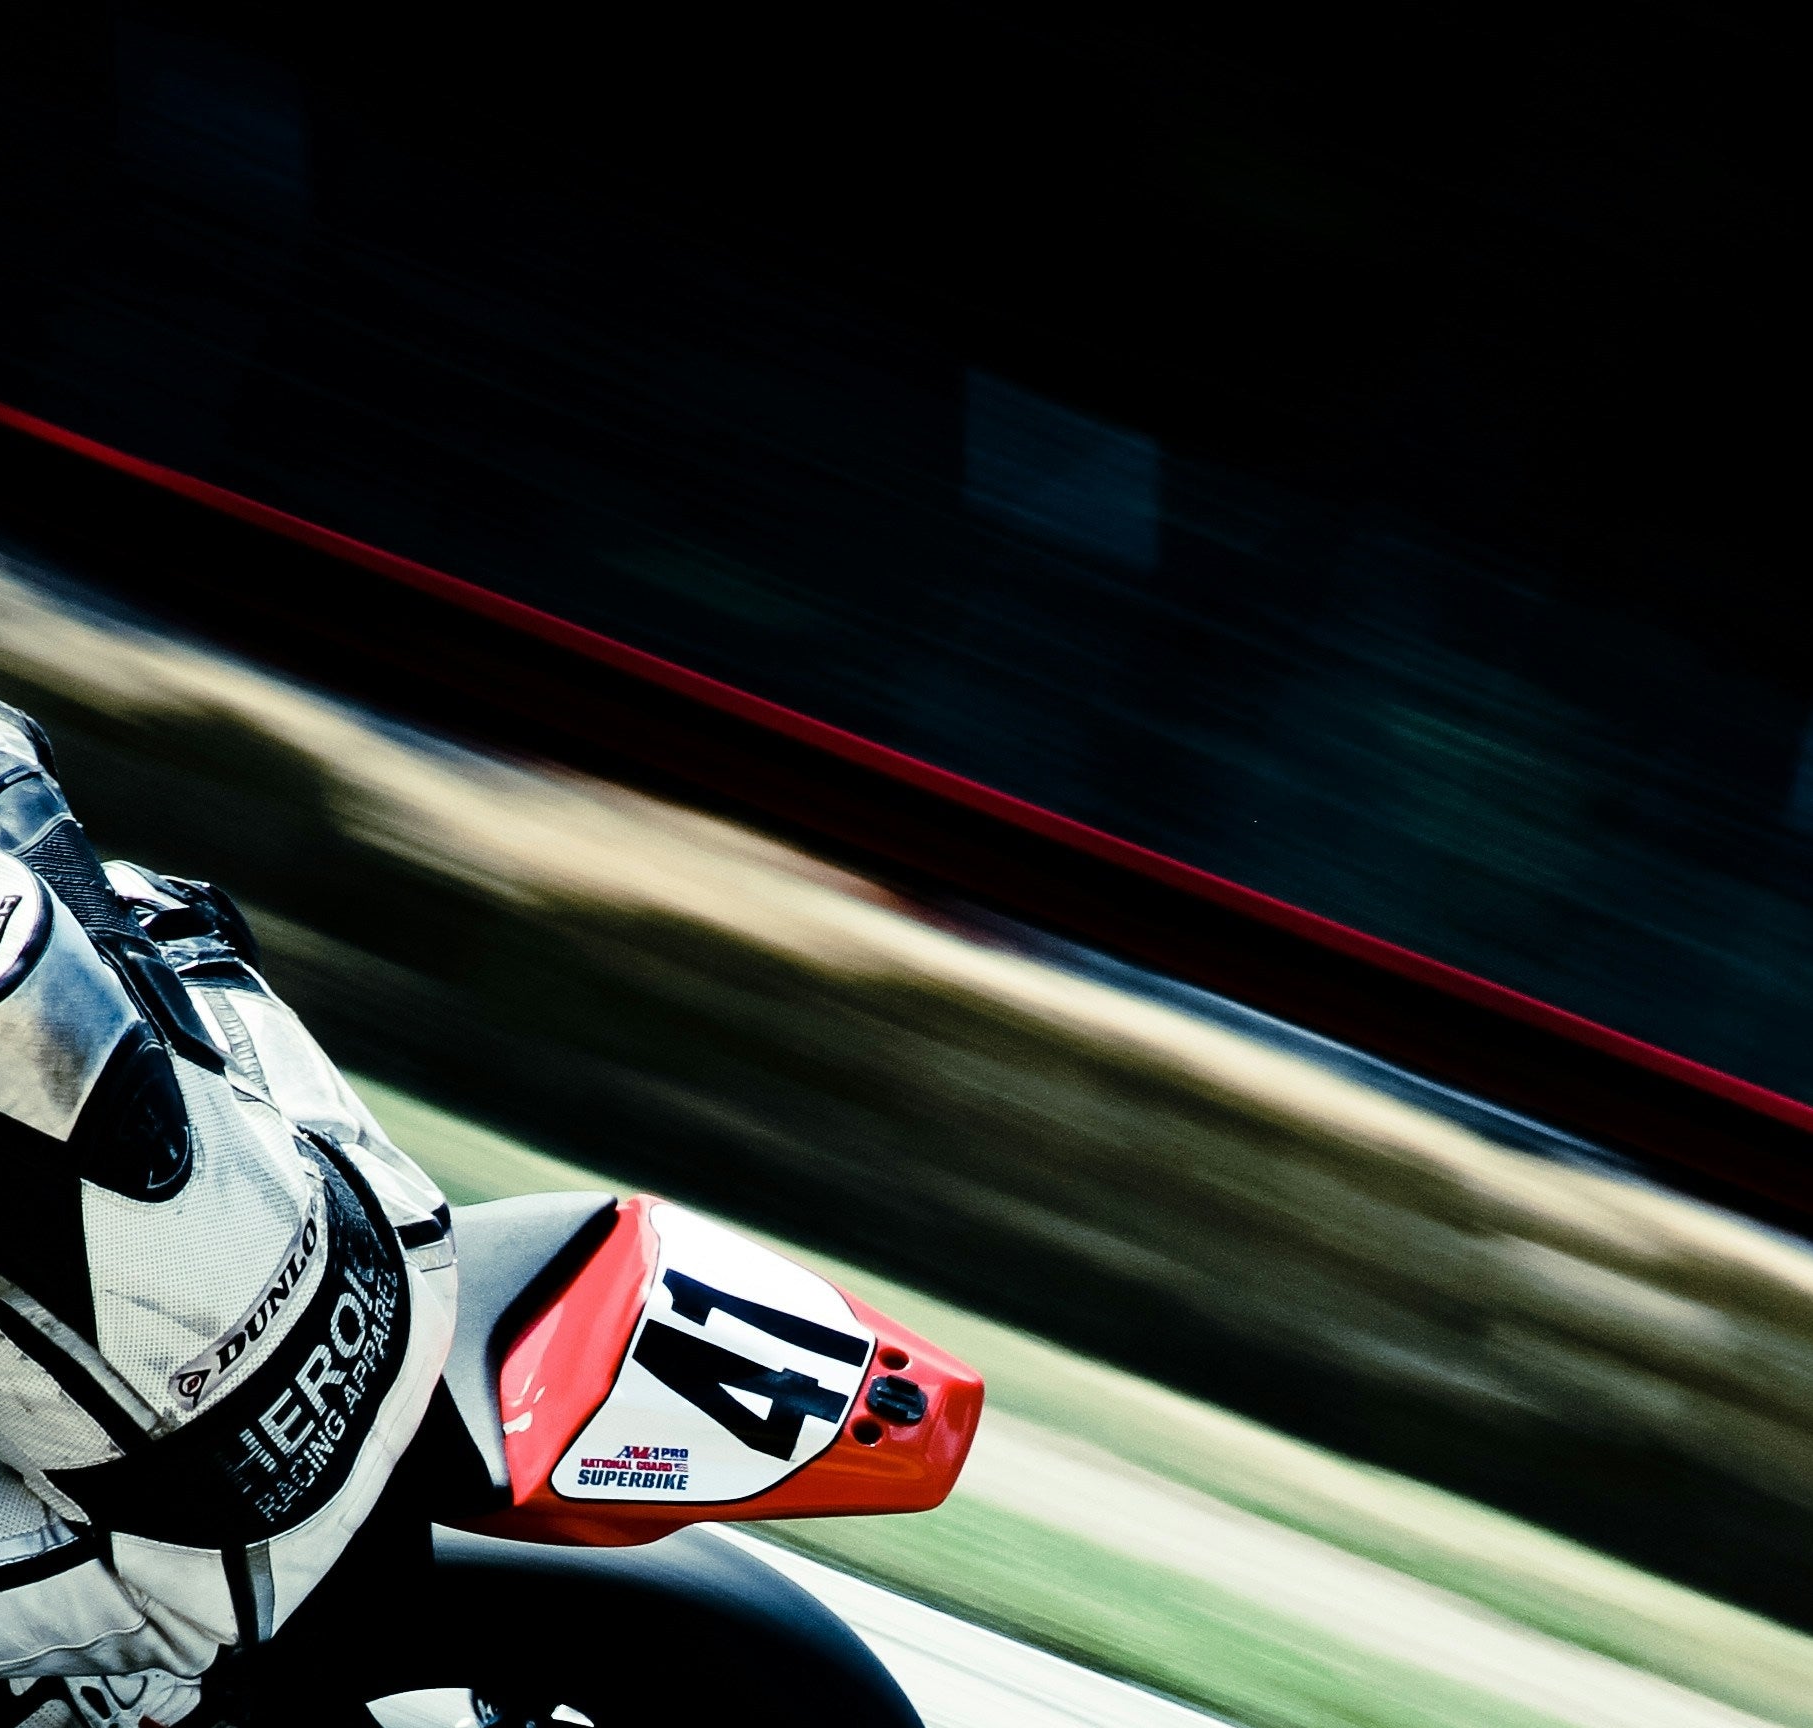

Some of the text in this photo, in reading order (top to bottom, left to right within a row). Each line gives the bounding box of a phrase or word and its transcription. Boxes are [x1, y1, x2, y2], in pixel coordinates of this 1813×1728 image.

[215, 1214, 319, 1376] DUNLO
[631, 1267, 871, 1462] 41
[254, 1412, 347, 1523] RACING
[577, 1468, 689, 1491] SUPERBIKE
[581, 1458, 673, 1473] NATIONAL GUARD
[661, 1447, 689, 1461] PRO
